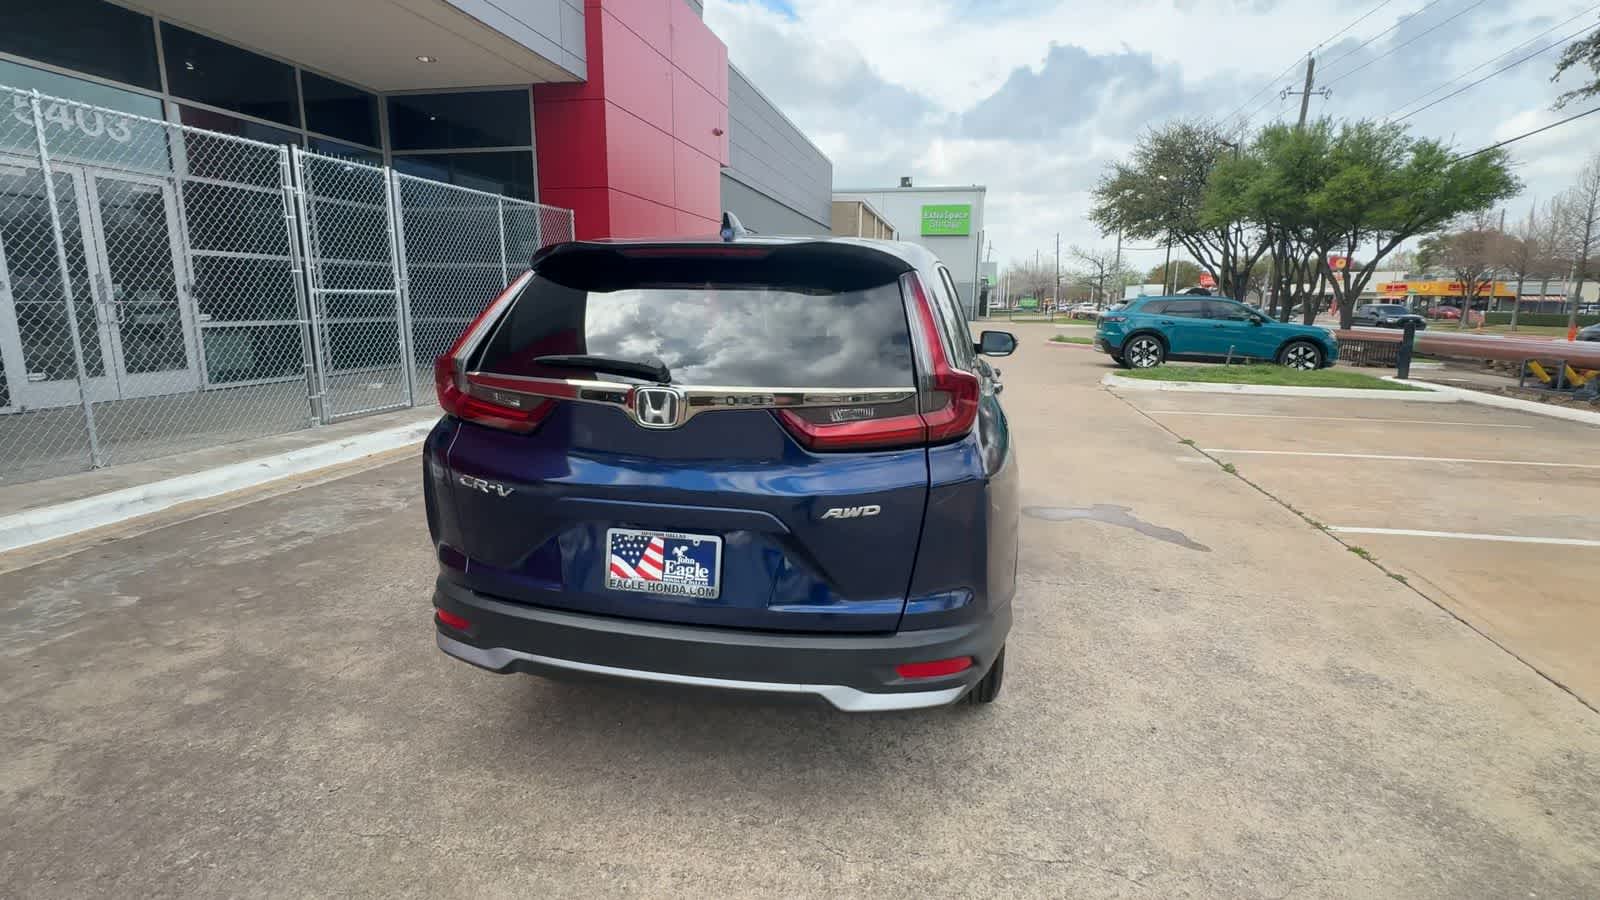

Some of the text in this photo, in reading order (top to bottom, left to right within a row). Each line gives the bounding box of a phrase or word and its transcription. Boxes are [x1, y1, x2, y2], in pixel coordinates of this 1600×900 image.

[459, 474, 515, 497] CR-V
[820, 504, 881, 520] AWD
[677, 556, 695, 565] John
[663, 560, 709, 580] Eagle
[609, 578, 645, 591] EAGLE
